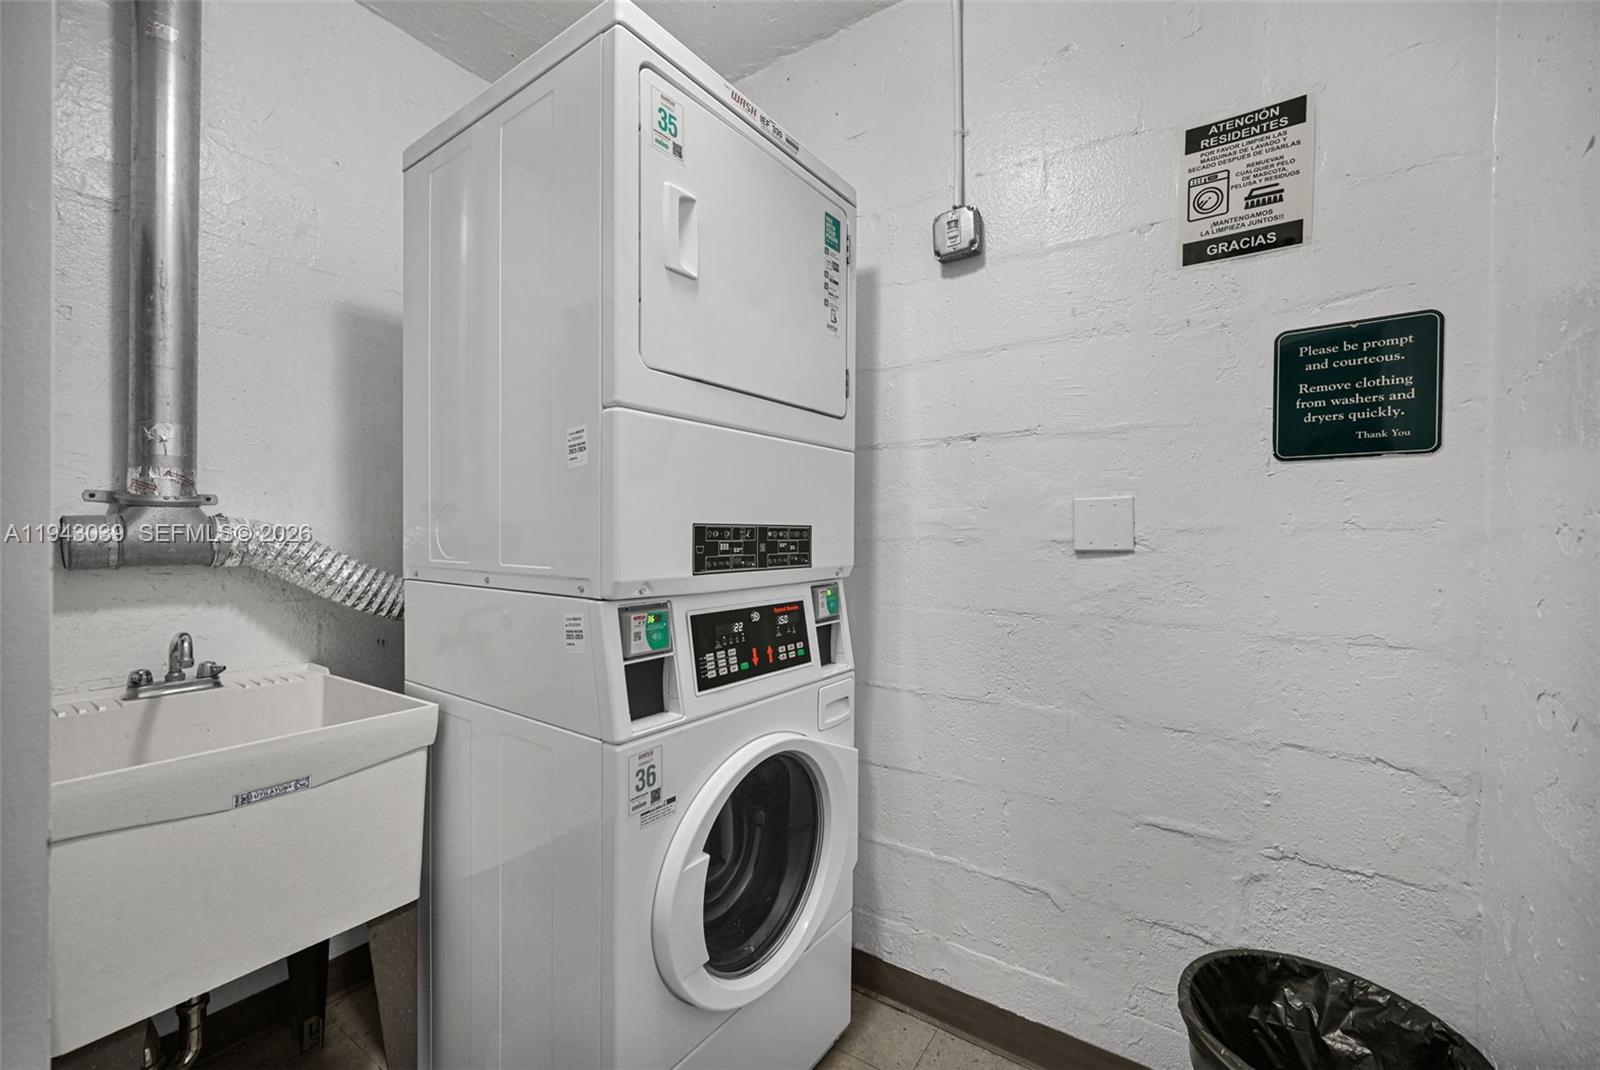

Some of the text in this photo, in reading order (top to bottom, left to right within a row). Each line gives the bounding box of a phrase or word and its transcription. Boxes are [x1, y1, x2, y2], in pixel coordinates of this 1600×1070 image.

[730, 90, 757, 117] WASH
[658, 107, 678, 138] 35
[1208, 106, 1280, 135] ATENCIÓN
[1200, 116, 1288, 149] RESIDENTES
[1200, 130, 1288, 158] POR FAVOR LIMPIEN LAS
[1239, 147, 1248, 155] DE
[1250, 138, 1280, 151] LAVADO
[1187, 161, 1216, 174] SECADO
[1253, 149, 1264, 157] DE
[1265, 139, 1302, 154] USARLAS
[1235, 158, 1296, 177] CUALQUIER PELO
[1246, 154, 1284, 169] REMUEVAN
[1230, 180, 1257, 190] PELUSA
[1264, 169, 1301, 182] RESIDUOS
[1211, 222, 1247, 235] LIMPIEZA
[1247, 213, 1284, 227] JUNTOS!!
[1206, 231, 1277, 256] GRACIAS
[1299, 334, 1415, 358] Please be prompt
[1305, 352, 1405, 371] and courteous.
[1298, 374, 1414, 395] Remove clothing
[1296, 388, 1416, 409] from washers and
[1303, 405, 1405, 424] dryers quickly.
[1355, 428, 1411, 439] Thank You
[635, 764, 656, 792] 36
